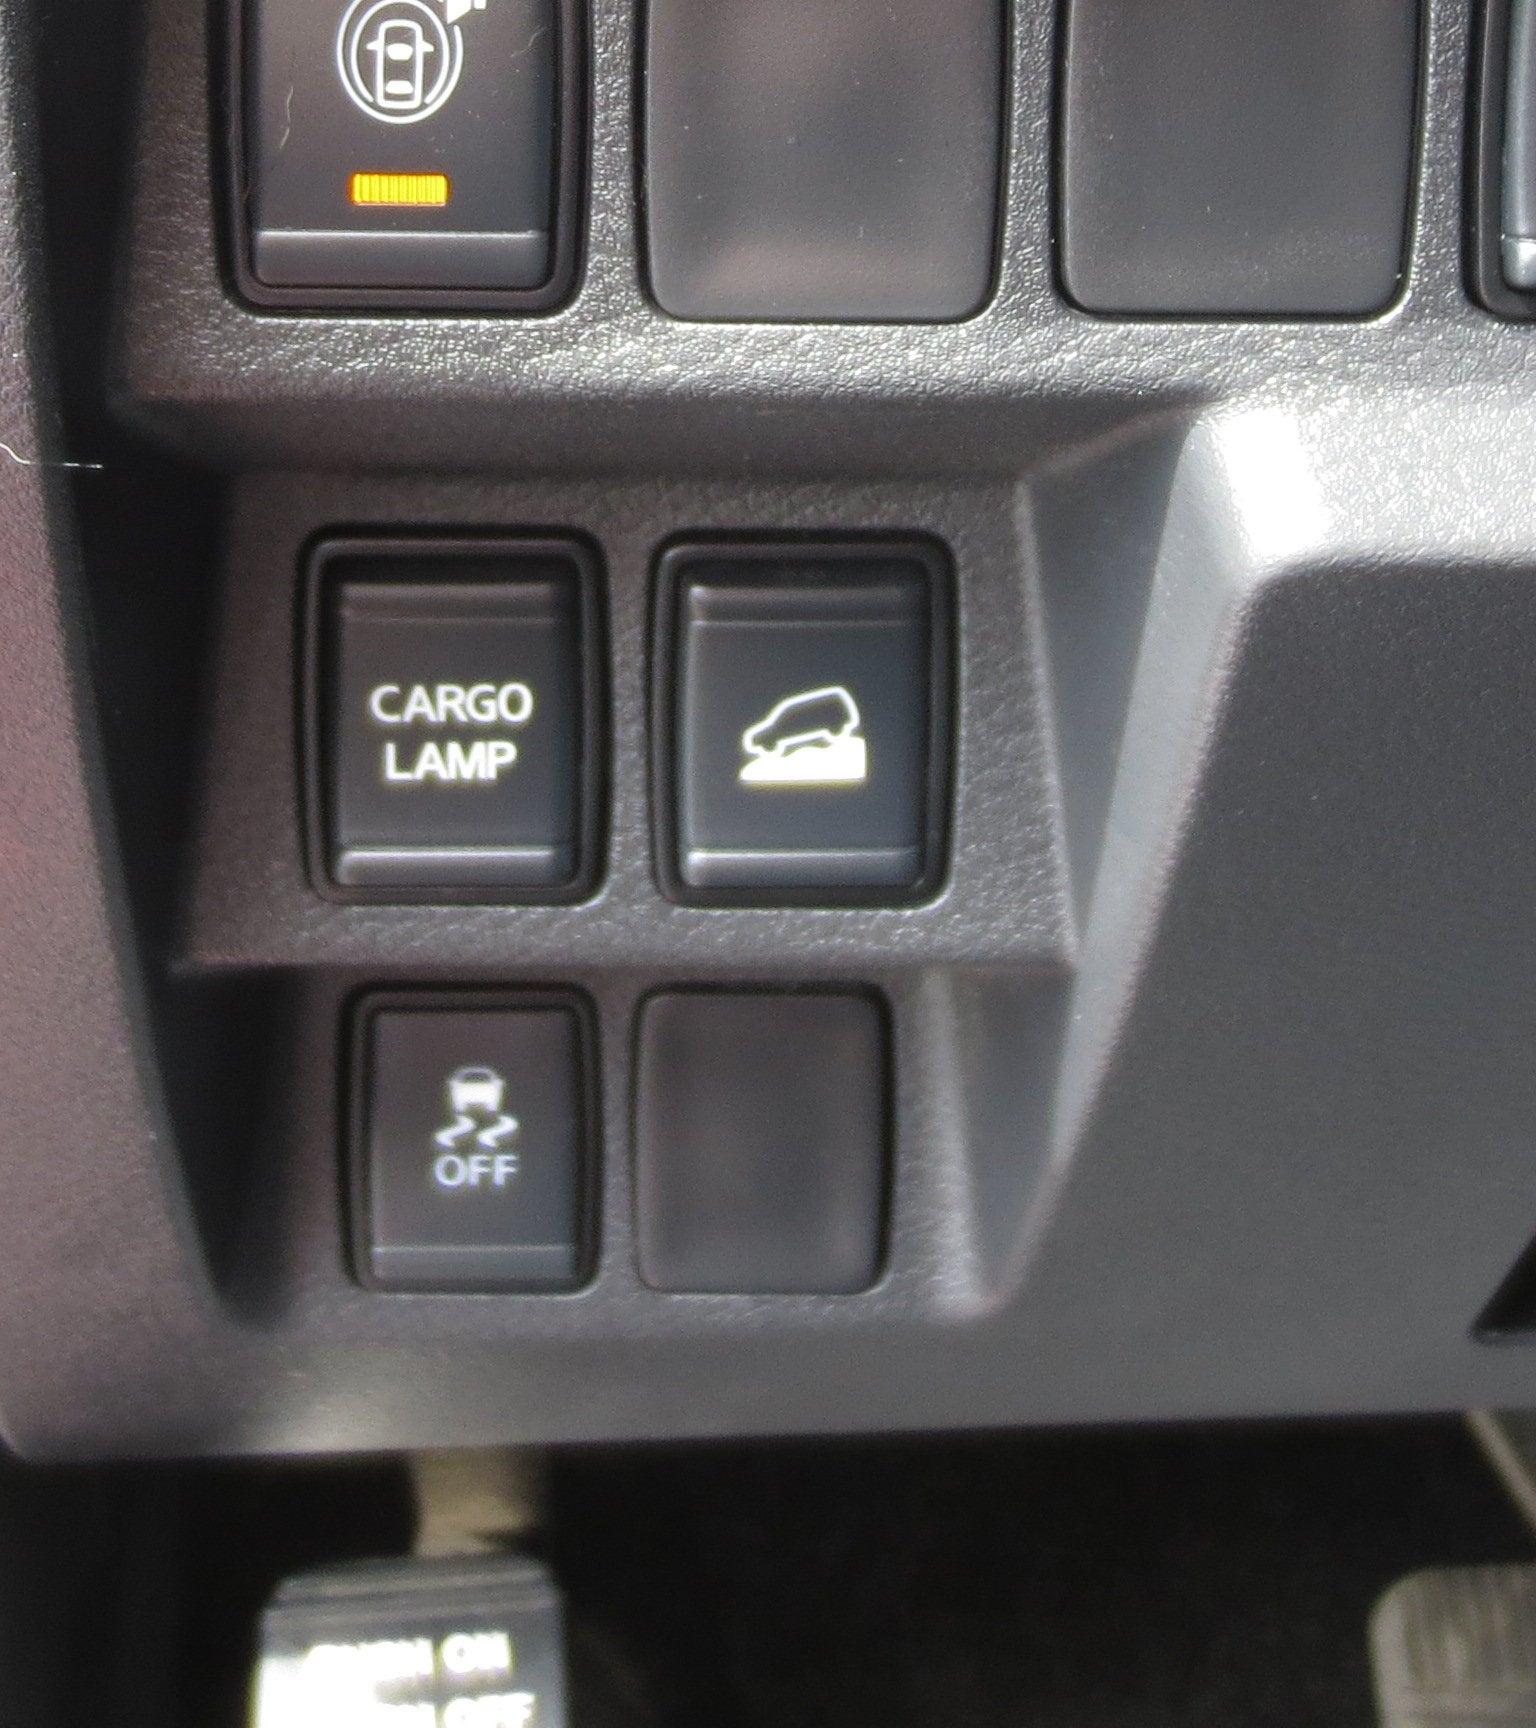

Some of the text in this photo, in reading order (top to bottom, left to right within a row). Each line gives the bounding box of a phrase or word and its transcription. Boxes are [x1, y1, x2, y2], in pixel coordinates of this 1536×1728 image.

[369, 682, 534, 724] CARGO
[384, 741, 517, 783] LAMP
[433, 1154, 519, 1188] OFF
